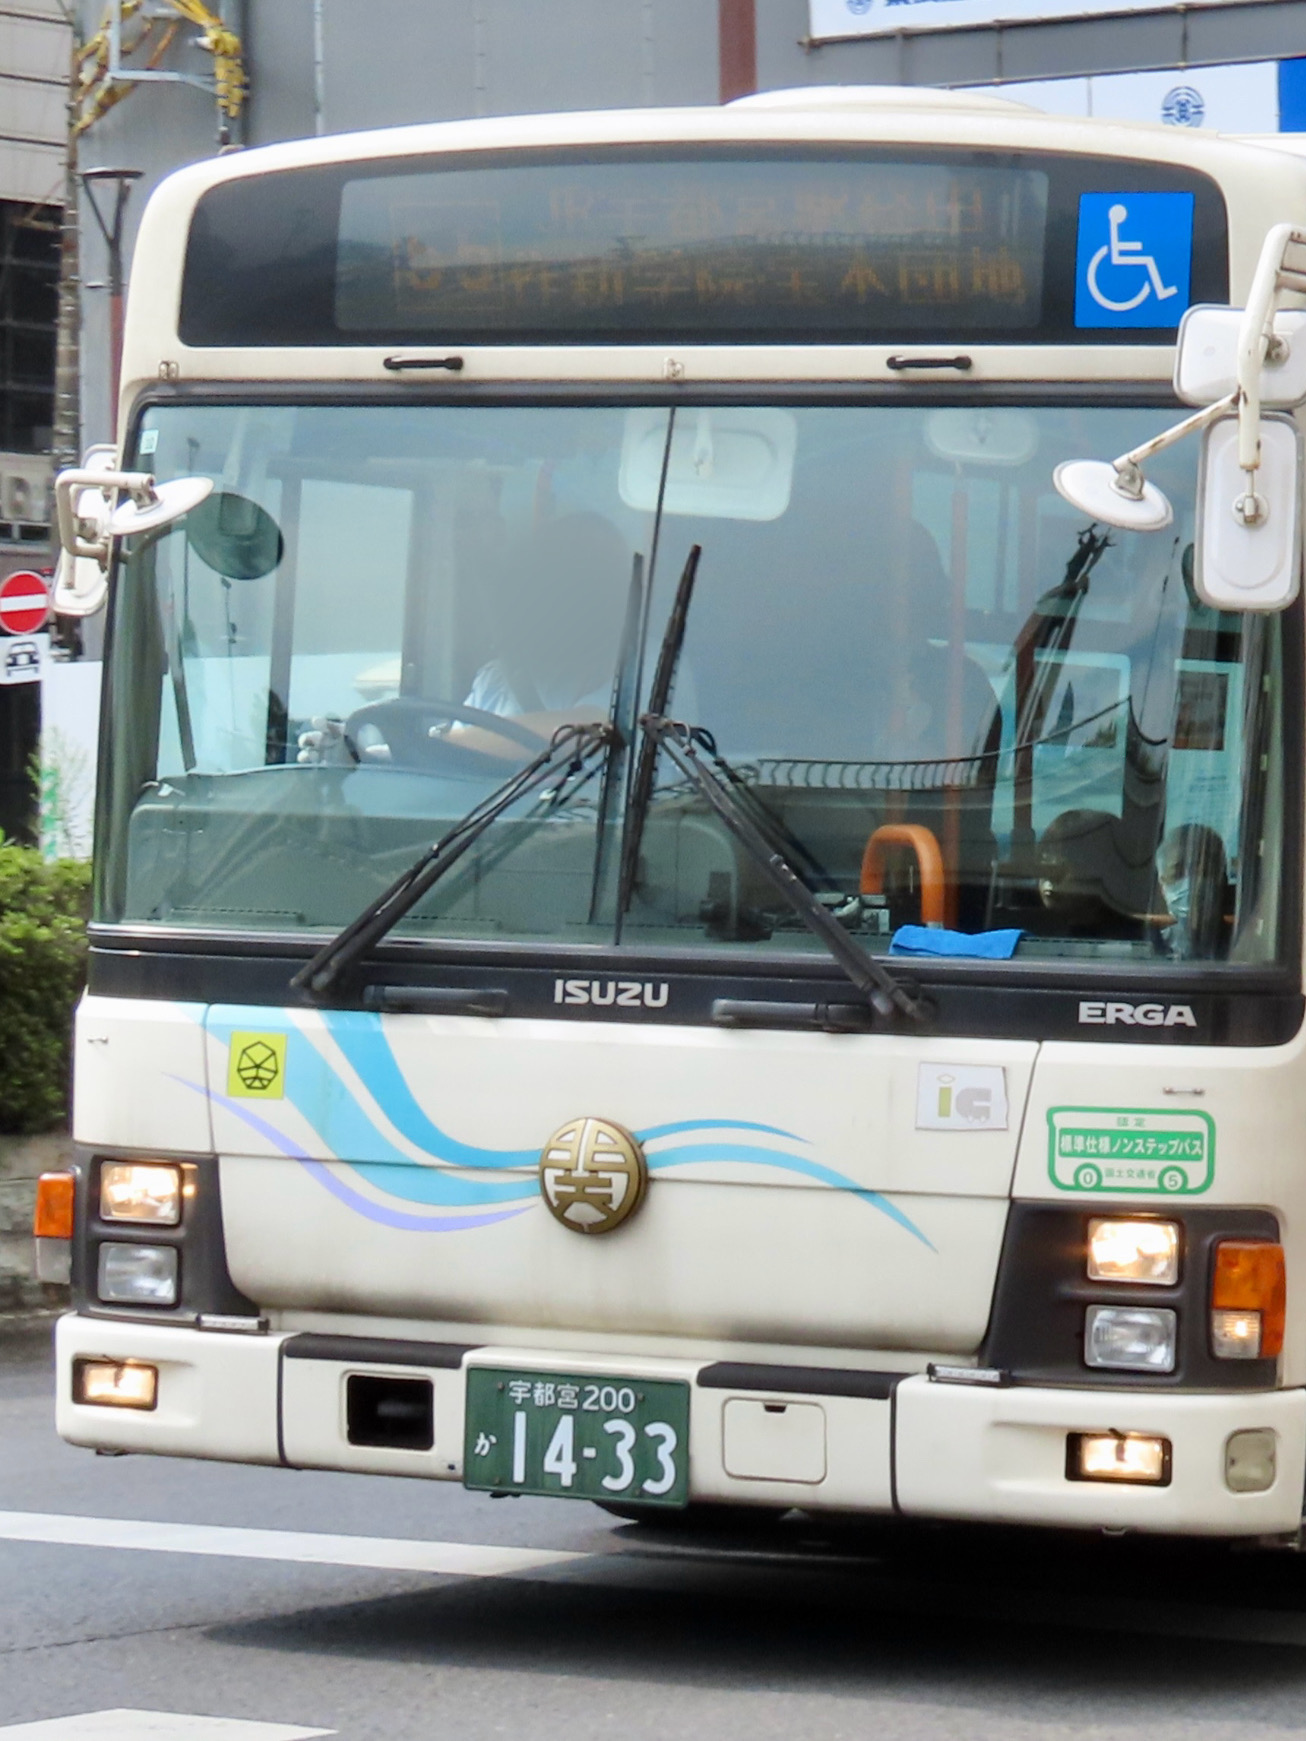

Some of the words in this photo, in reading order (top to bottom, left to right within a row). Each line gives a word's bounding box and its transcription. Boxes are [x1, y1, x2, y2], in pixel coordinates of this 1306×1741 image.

[554, 979, 669, 1007] ISUZU
[1078, 1001, 1197, 1027] ERGA
[1116, 1117, 1146, 1128] 認定
[1060, 1134, 1203, 1155] 標準仕様ノンステップバス
[1083, 1171, 1093, 1185] 0
[1105, 1167, 1156, 1180] 国土交通省
[1168, 1174, 1178, 1188] 5
[474, 1432, 497, 1457] か
[512, 1410, 678, 1495] 14-33
